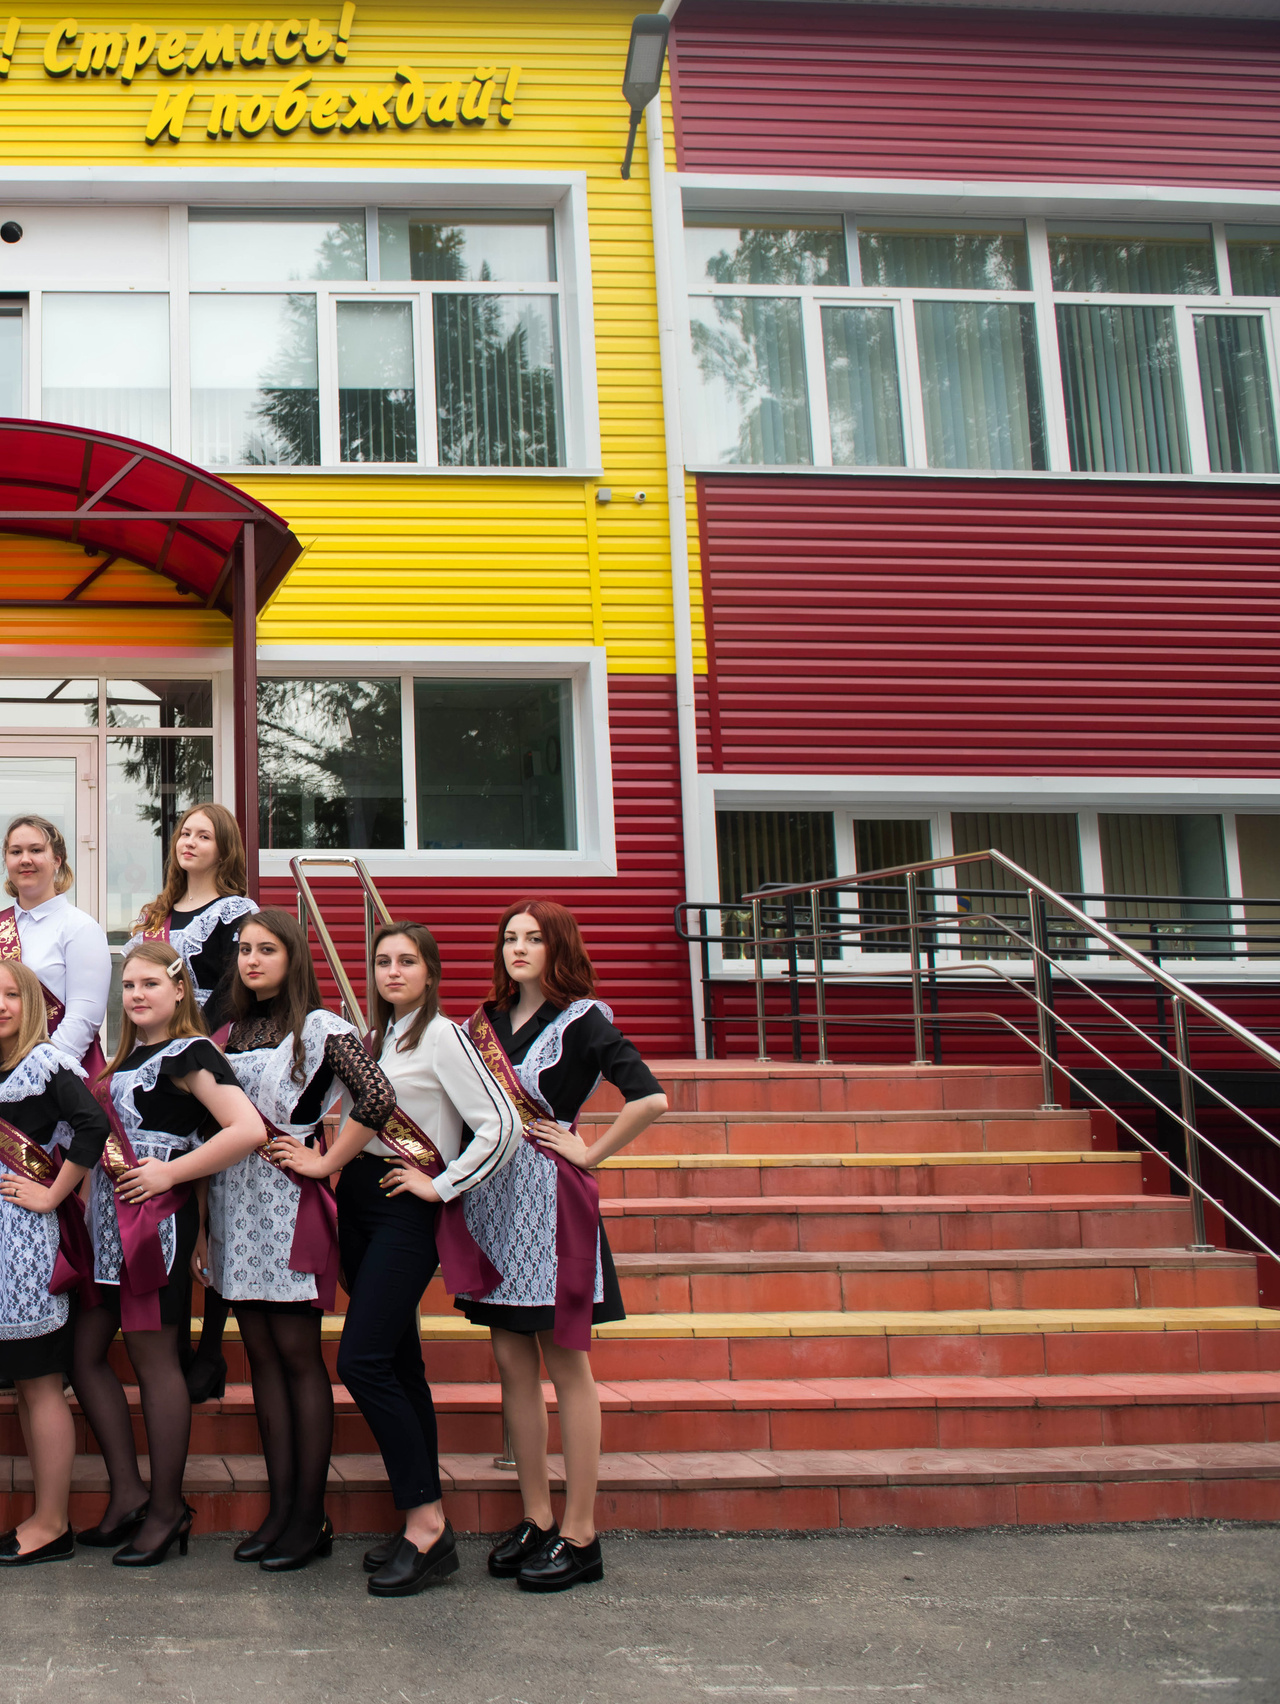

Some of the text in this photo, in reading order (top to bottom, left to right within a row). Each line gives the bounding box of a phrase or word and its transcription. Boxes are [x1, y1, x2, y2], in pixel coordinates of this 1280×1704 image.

[43, 1, 357, 86] Стремись!
[144, 65, 522, 146] И побеждай!
